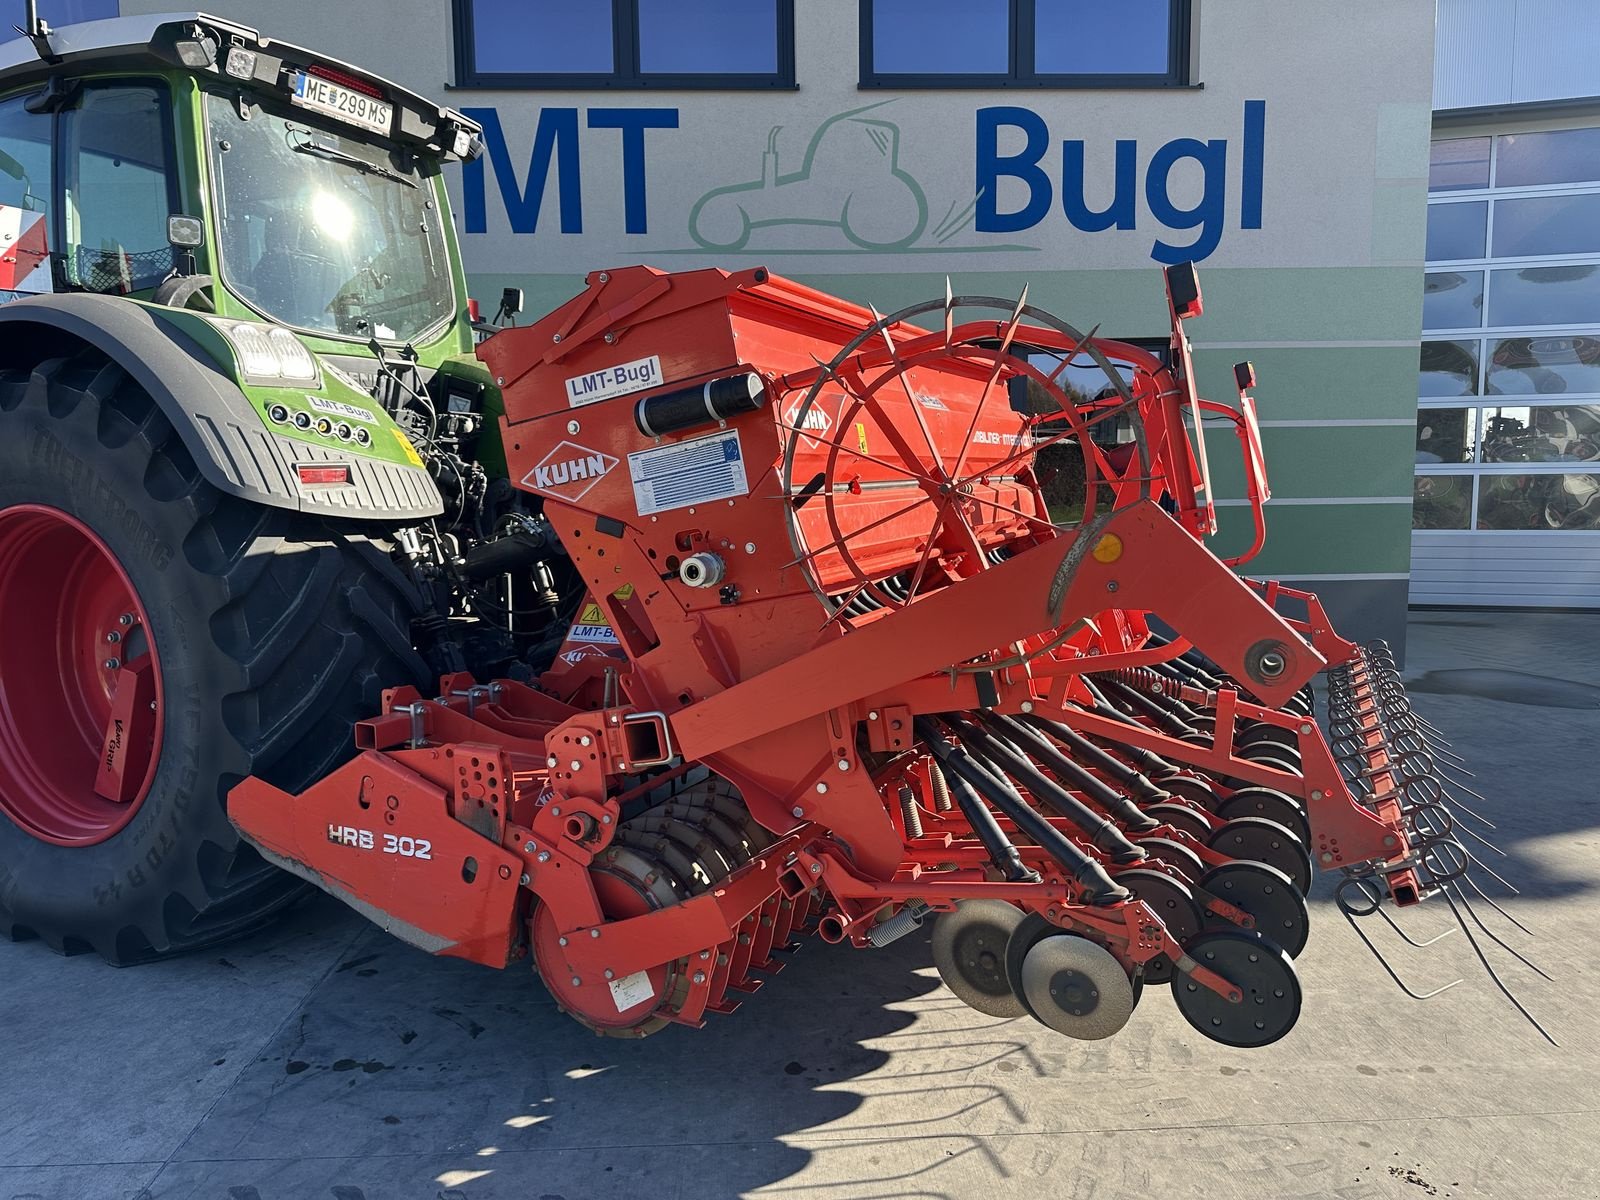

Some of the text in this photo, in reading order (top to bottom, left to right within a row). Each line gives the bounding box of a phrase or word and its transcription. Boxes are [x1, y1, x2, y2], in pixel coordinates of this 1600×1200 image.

[306, 79, 328, 104] ME
[338, 92, 367, 118] 299
[368, 102, 387, 124] MS
[454, 99, 1266, 265] MT Bugl
[571, 358, 655, 397] LMT-Bugl
[310, 396, 373, 421] LMT-Bugl
[534, 454, 606, 488] KUHN
[572, 626, 617, 638] LMT-B
[105, 739, 116, 773] GRIP
[327, 823, 432, 860] HRB 302
